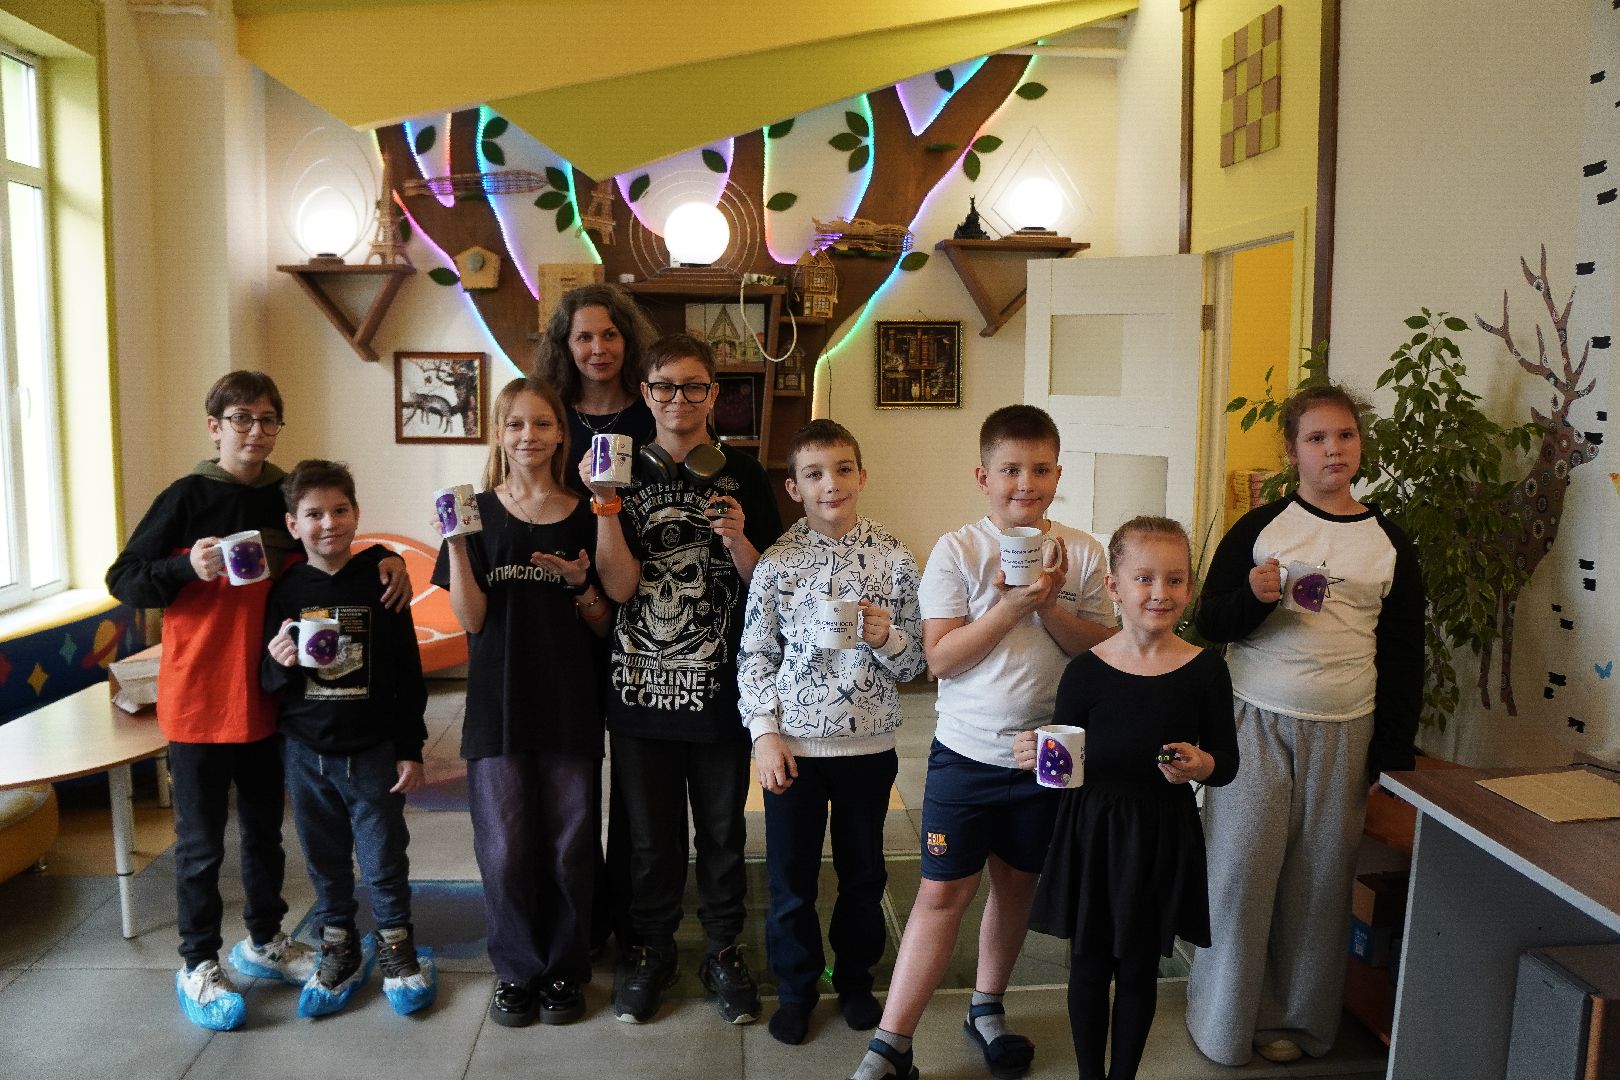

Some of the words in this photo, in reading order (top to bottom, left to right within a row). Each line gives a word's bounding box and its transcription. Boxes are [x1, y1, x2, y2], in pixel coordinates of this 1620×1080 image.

[664, 493, 673, 502] IS
[495, 564, 561, 583] ПРИСЛОНЯ
[622, 666, 706, 690] MARINE
[621, 685, 704, 712] CORPS
[646, 683, 680, 695] RUSSIAN
